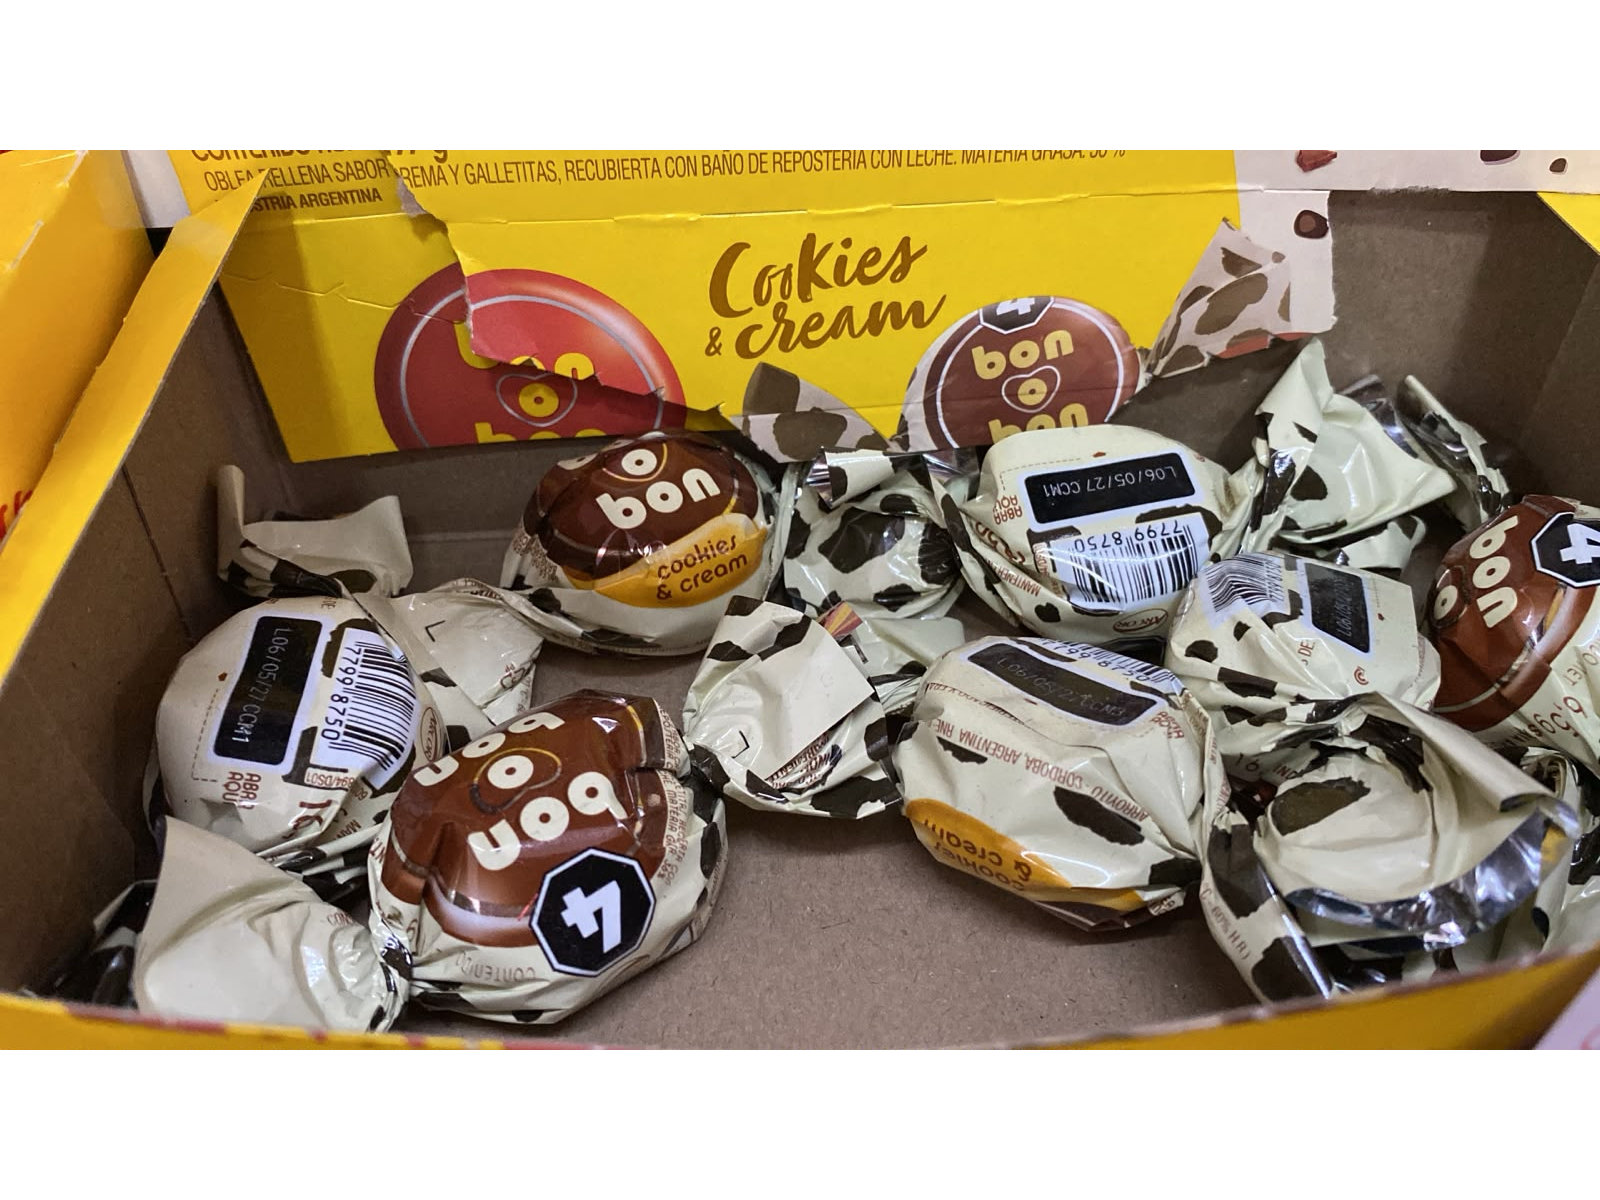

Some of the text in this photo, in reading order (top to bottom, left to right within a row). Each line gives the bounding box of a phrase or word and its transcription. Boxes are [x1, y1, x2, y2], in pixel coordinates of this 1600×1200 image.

[333, 157, 390, 183] SABOR
[448, 164, 459, 185] Y
[464, 160, 562, 185] GALLETITAS,
[565, 157, 662, 182] RECUBIERTA
[665, 155, 697, 178] CON
[701, 150, 743, 177] BAÑO
[749, 152, 768, 174] DE
[871, 150, 902, 169] CON
[907, 150, 957, 168] LECHE.
[300, 187, 382, 208] ARGENTINA
[709, 233, 928, 318] Cookies
[704, 294, 947, 360] & cream
[971, 329, 1074, 380] bon
[518, 383, 559, 417] o
[1018, 378, 1048, 405] o
[621, 448, 657, 476] o
[1043, 465, 1177, 498] L06/05/27 CCM1
[596, 468, 721, 529] bon
[1074, 520, 1184, 553] 7799 8750
[1560, 523, 1600, 564] 4
[656, 534, 737, 581] cookies
[656, 552, 748, 601] & cream
[1469, 515, 1519, 628] bon
[1433, 584, 1458, 621] o
[231, 628, 294, 744] L06/05/27 CCM1
[320, 646, 362, 742] 7799 8750
[413, 711, 566, 787] bon
[958, 728, 1023, 765] ARGENTINA
[487, 754, 535, 790] o
[468, 771, 628, 871] bon
[1014, 859, 1032, 882] &
[560, 881, 622, 954] 4
